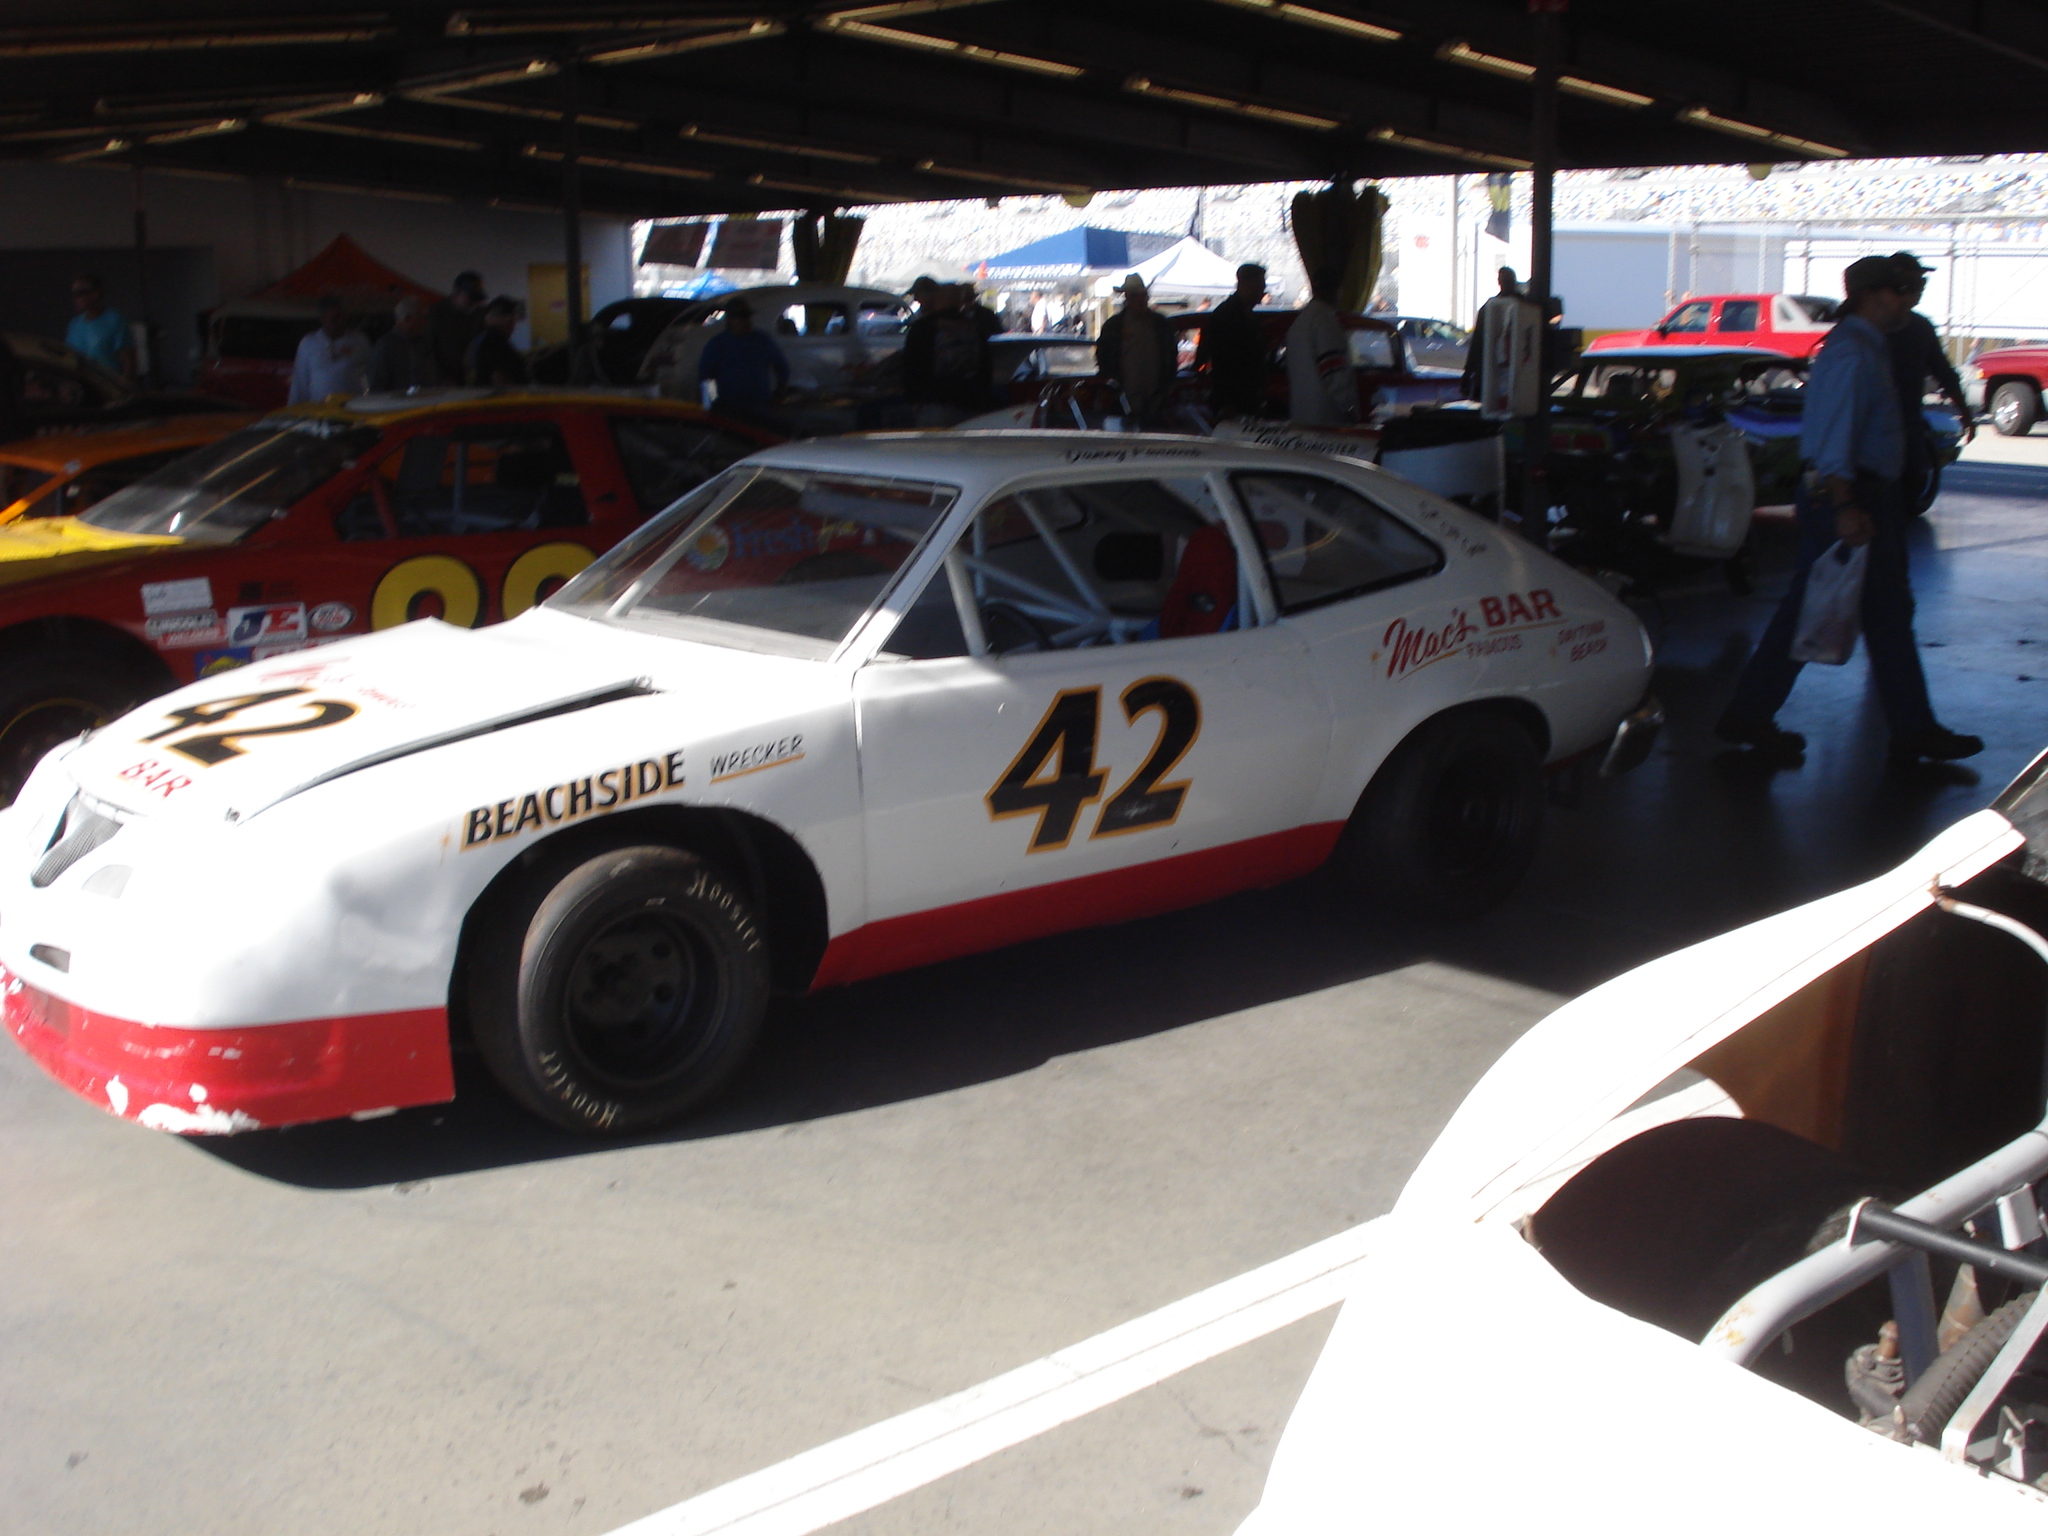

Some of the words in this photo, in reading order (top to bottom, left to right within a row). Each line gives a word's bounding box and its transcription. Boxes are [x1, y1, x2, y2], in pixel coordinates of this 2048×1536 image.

[1383, 606, 1480, 679] Mac's
[1479, 588, 1563, 629] BAR
[134, 686, 362, 769] 42
[709, 733, 804, 779] WRECKER
[983, 674, 1204, 856] 42
[116, 758, 193, 801] BAR
[460, 747, 685, 854] BEACHSIDE
[685, 868, 762, 953] Hoosier
